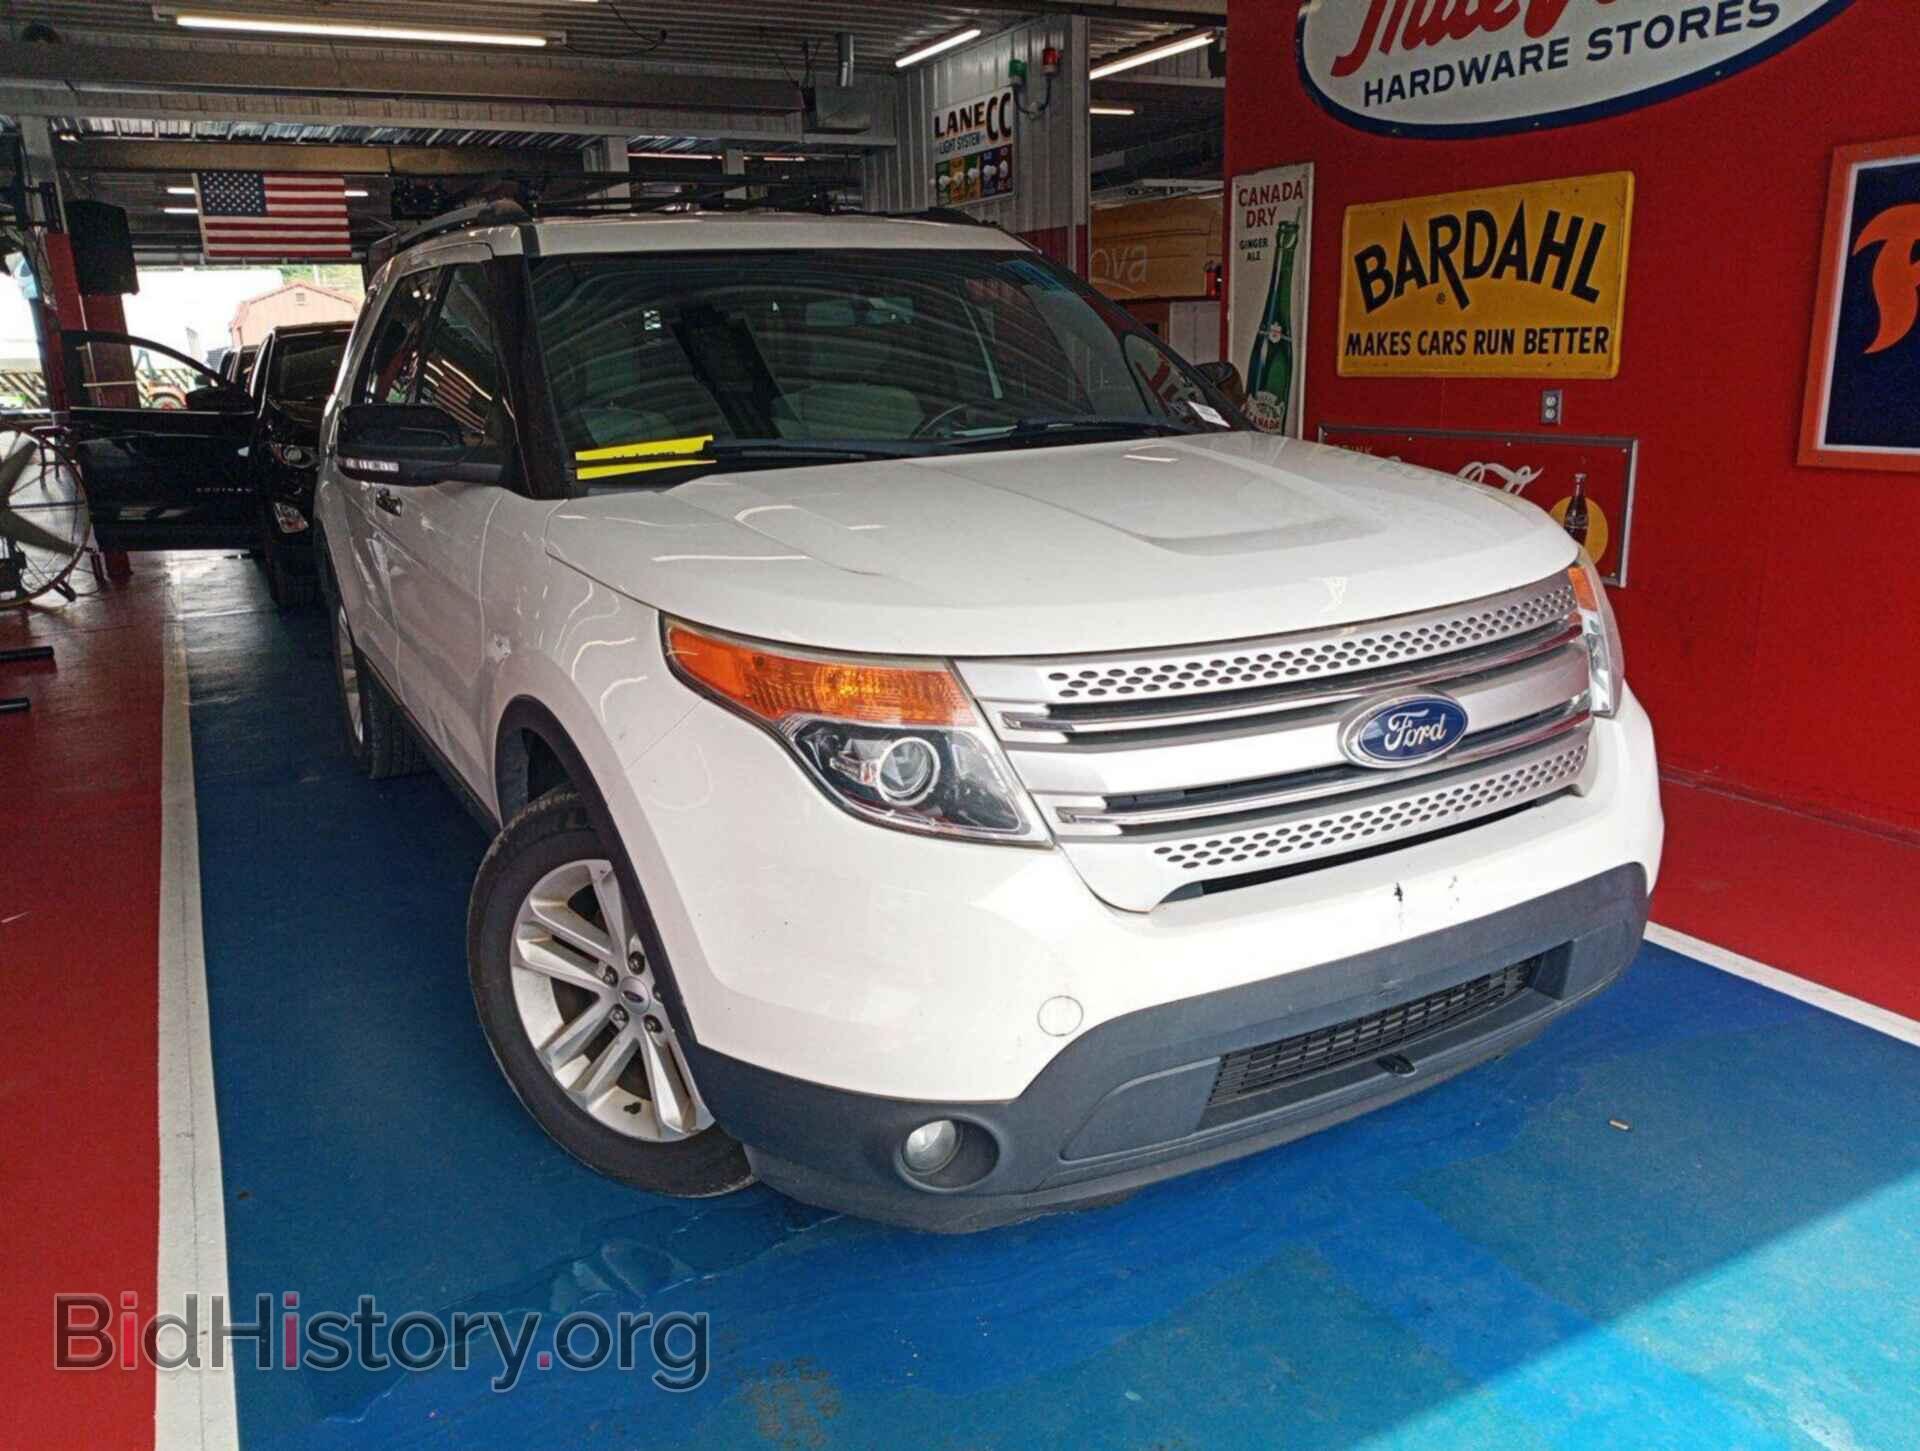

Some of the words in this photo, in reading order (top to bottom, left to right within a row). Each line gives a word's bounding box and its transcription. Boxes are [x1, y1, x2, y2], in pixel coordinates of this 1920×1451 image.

[1363, 36, 1570, 108] HARDWARE
[1585, 0, 1780, 61] STORES
[934, 101, 985, 138] LANE
[986, 91, 1012, 141] CC
[1238, 180, 1304, 207] CANADA
[1245, 206, 1278, 229] DRY
[1239, 237, 1268, 251] GINGER
[1246, 251, 1262, 262] ALE
[1353, 199, 1607, 314] BARDAHL
[1344, 331, 1412, 357] MAKES
[1416, 329, 1468, 357] CARS
[1472, 328, 1516, 356] RUN
[1523, 325, 1610, 355] BETTER
[1383, 708, 1448, 752] Ford
